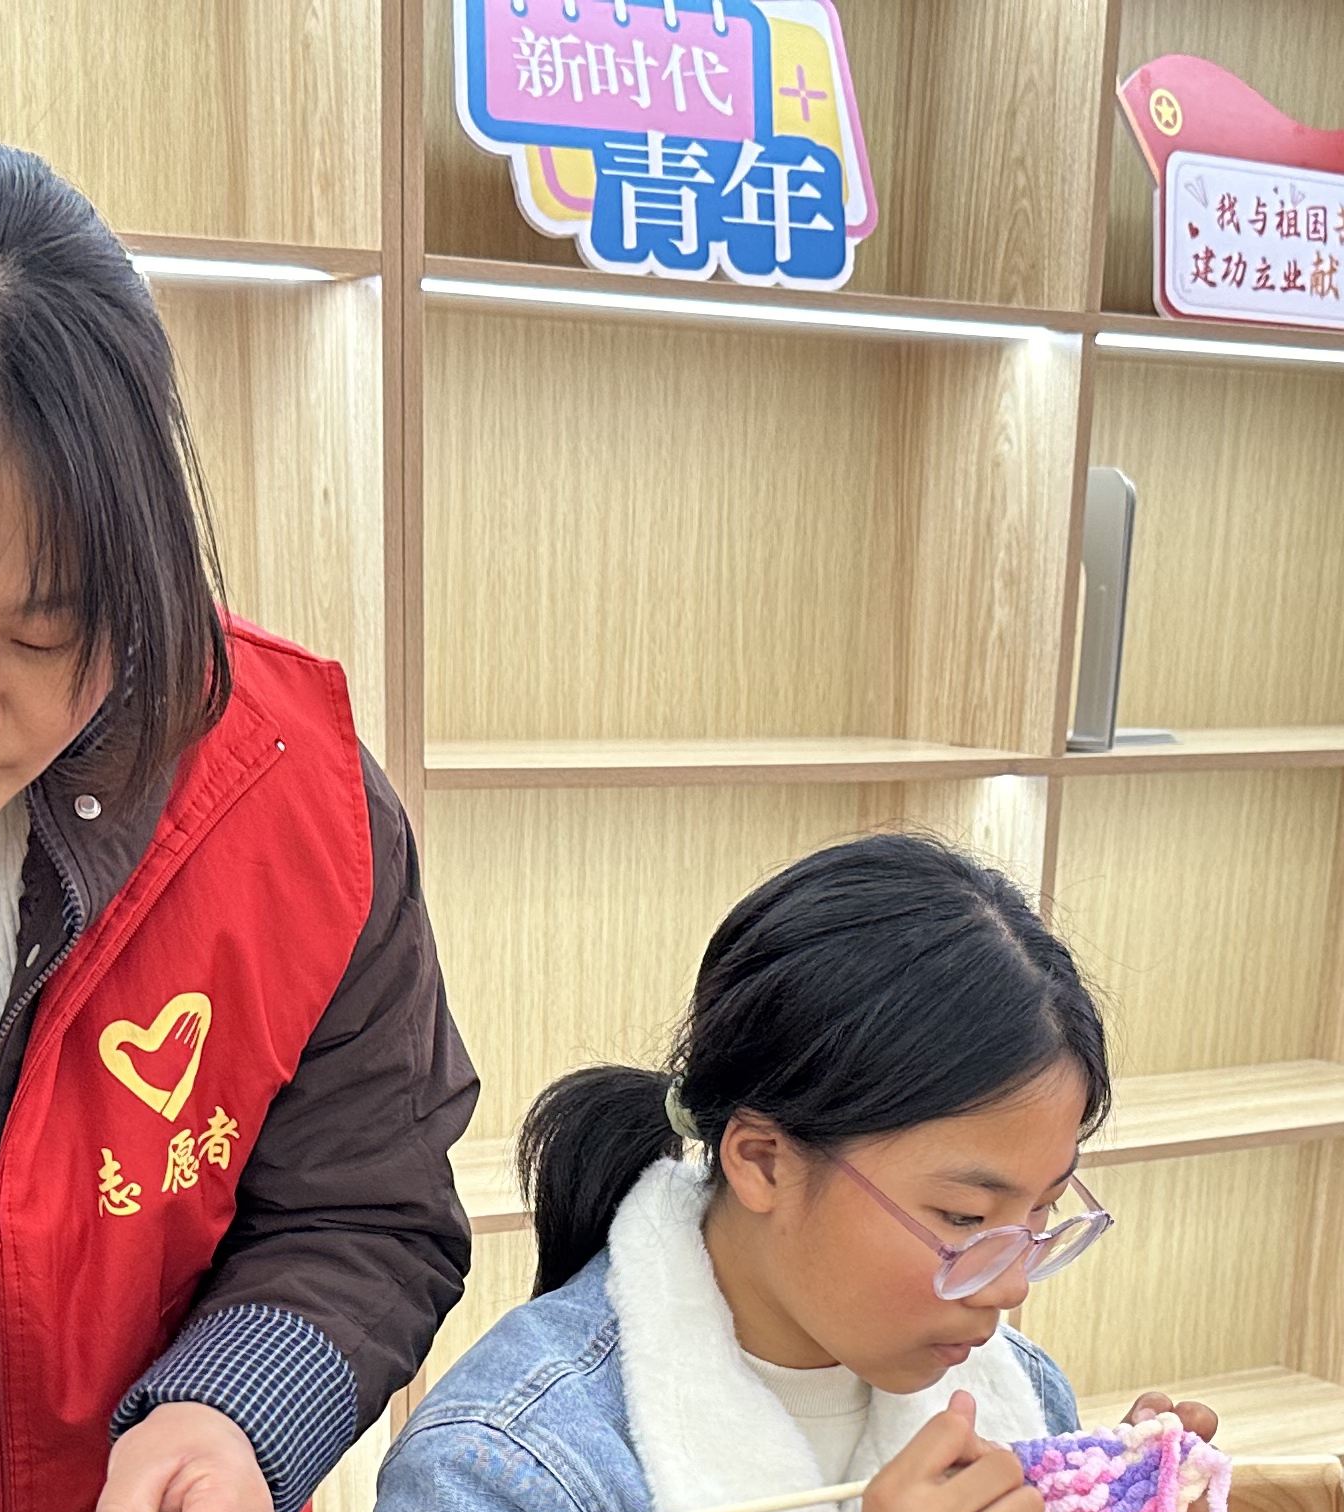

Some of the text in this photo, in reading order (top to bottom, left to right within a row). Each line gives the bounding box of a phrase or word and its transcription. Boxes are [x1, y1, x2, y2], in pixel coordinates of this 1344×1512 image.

[511, 26, 734, 117] 新时代
[601, 130, 835, 263] 青年
[96, 1105, 240, 1218] 志愿者
